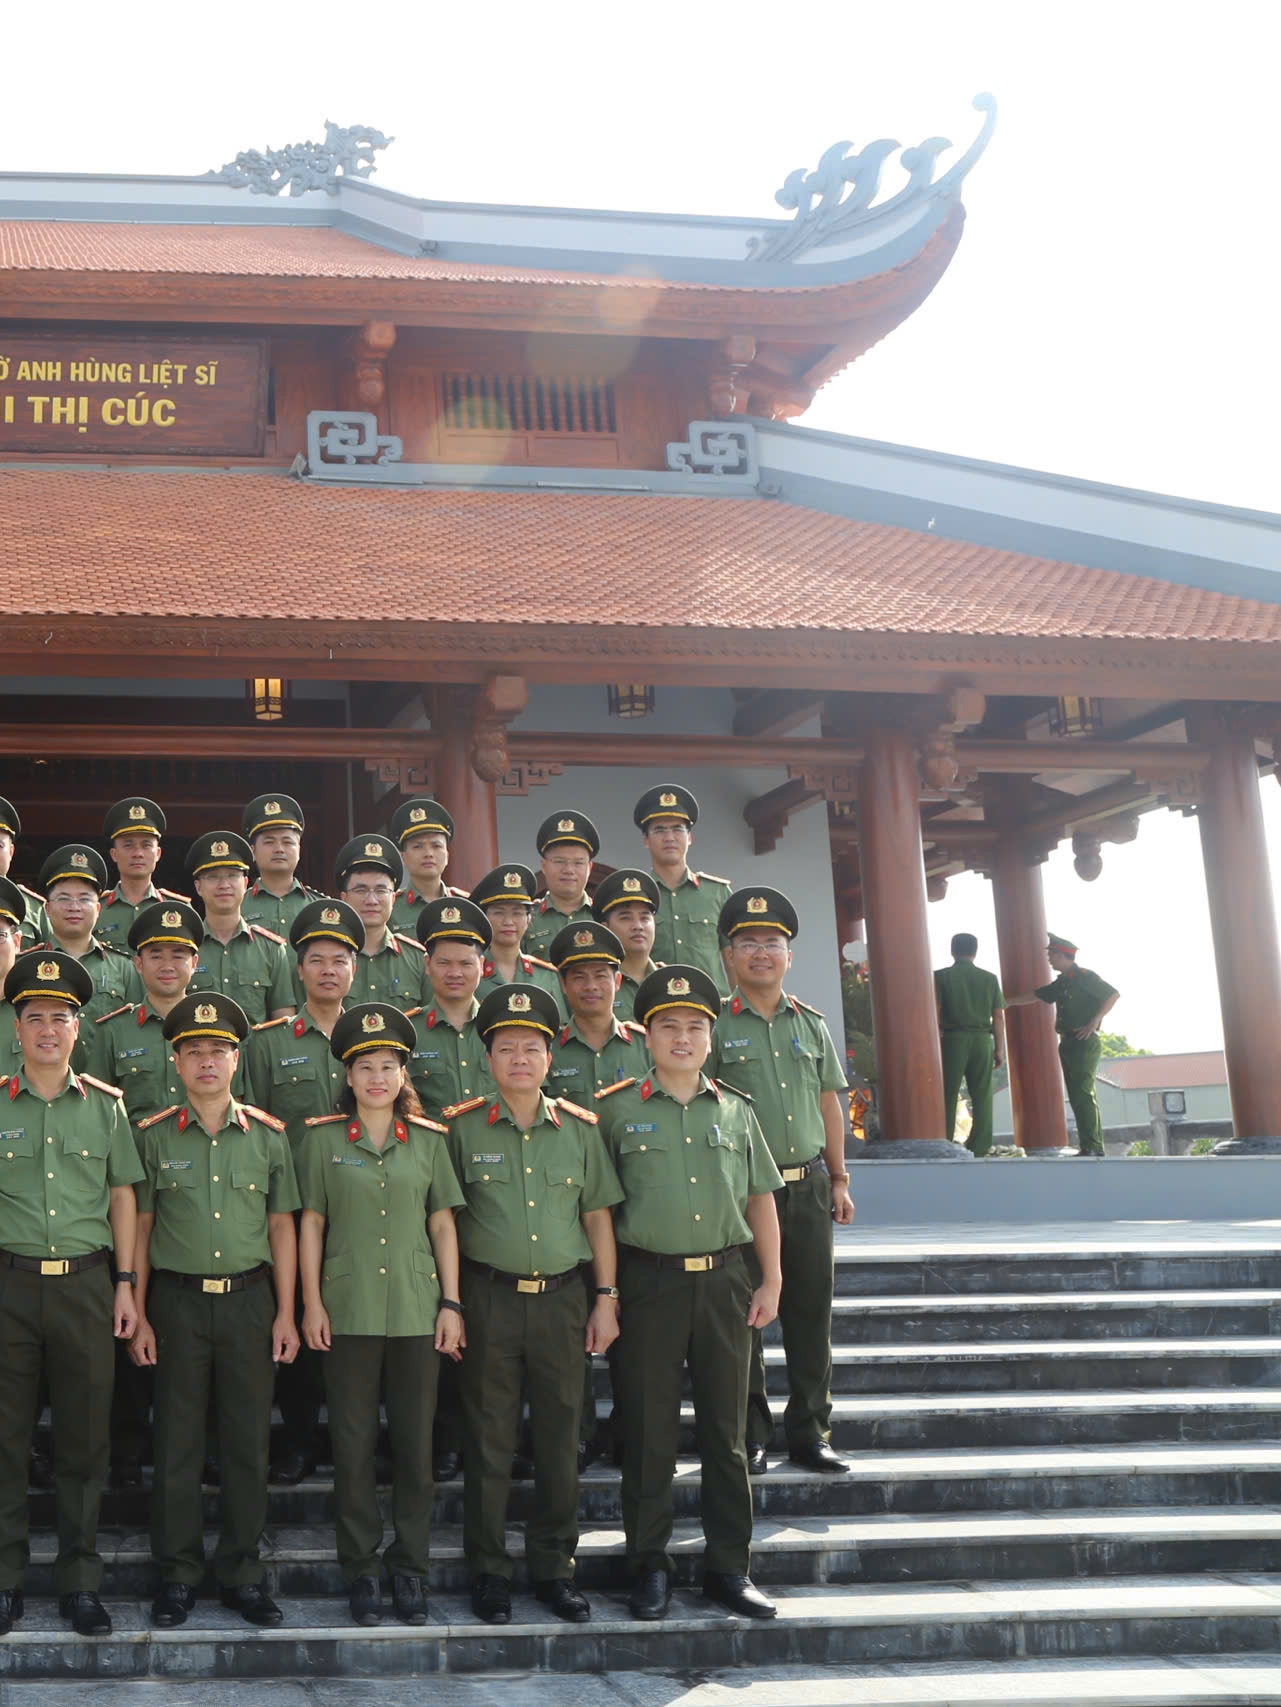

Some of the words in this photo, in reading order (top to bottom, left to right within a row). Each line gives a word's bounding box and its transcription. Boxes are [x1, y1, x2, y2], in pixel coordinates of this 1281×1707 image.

[16, 360, 62, 382] ANH
[70, 357, 132, 384] HÙNG
[139, 359, 188, 388] LIỆT
[194, 360, 218, 385] SĨ
[26, 395, 89, 433] THỊ
[101, 391, 177, 428] CÚC
